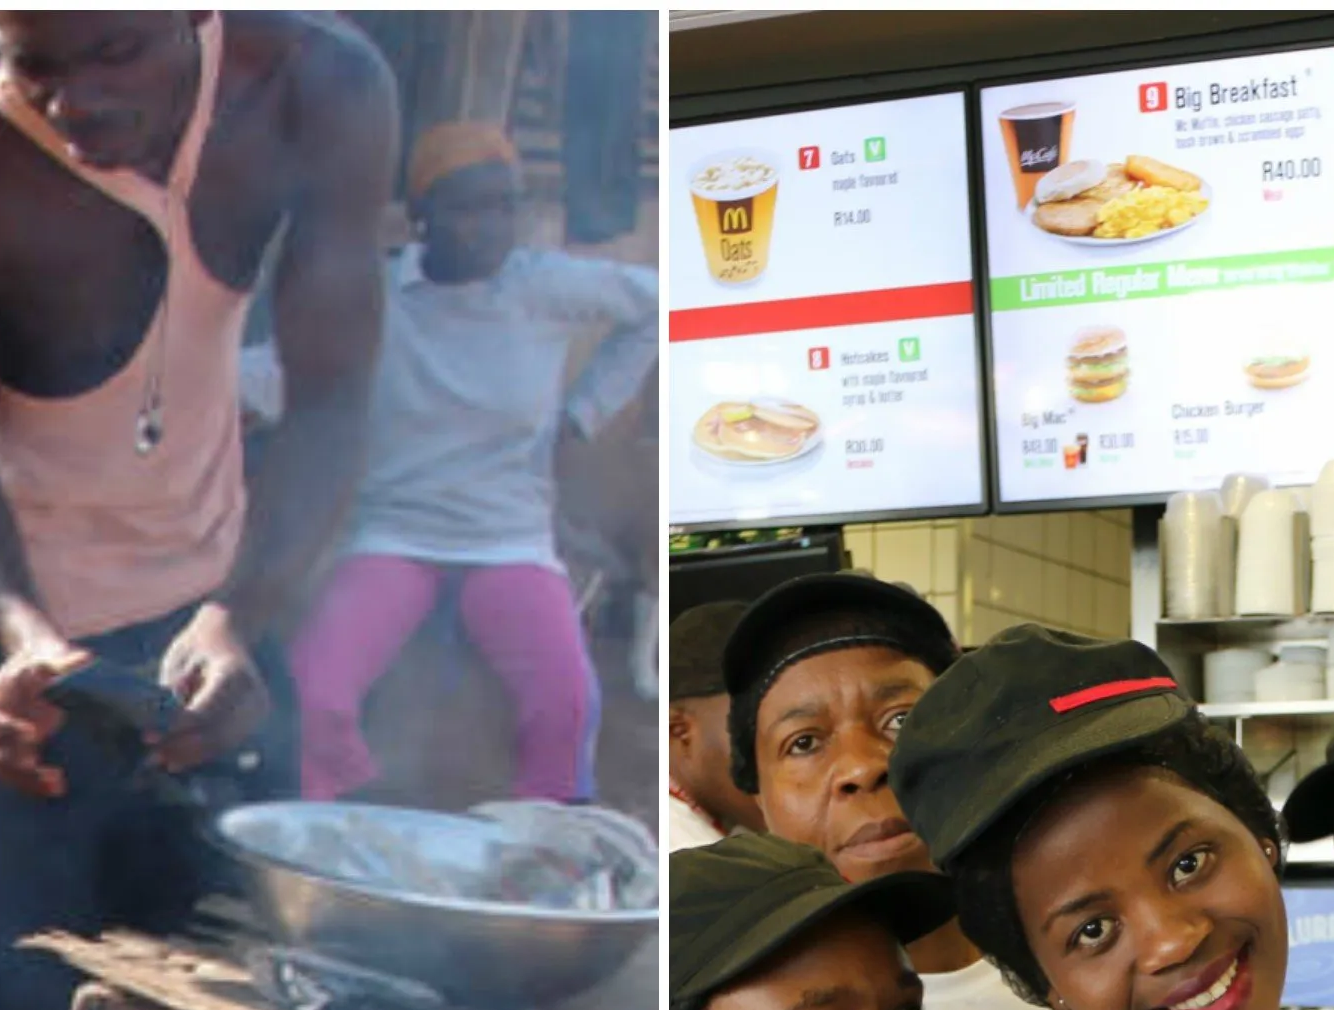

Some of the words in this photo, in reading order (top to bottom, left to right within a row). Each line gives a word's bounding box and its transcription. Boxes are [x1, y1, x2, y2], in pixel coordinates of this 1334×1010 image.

[1174, 86, 1203, 112] Big
[1209, 75, 1298, 106] Breakfast
[1262, 157, 1322, 182] R40.00
[720, 237, 754, 262] Oats
[1020, 275, 1085, 301] Limited
[1092, 266, 1161, 297] Regular
[1171, 402, 1218, 420] Chicken
[1224, 400, 1265, 418] Burger
